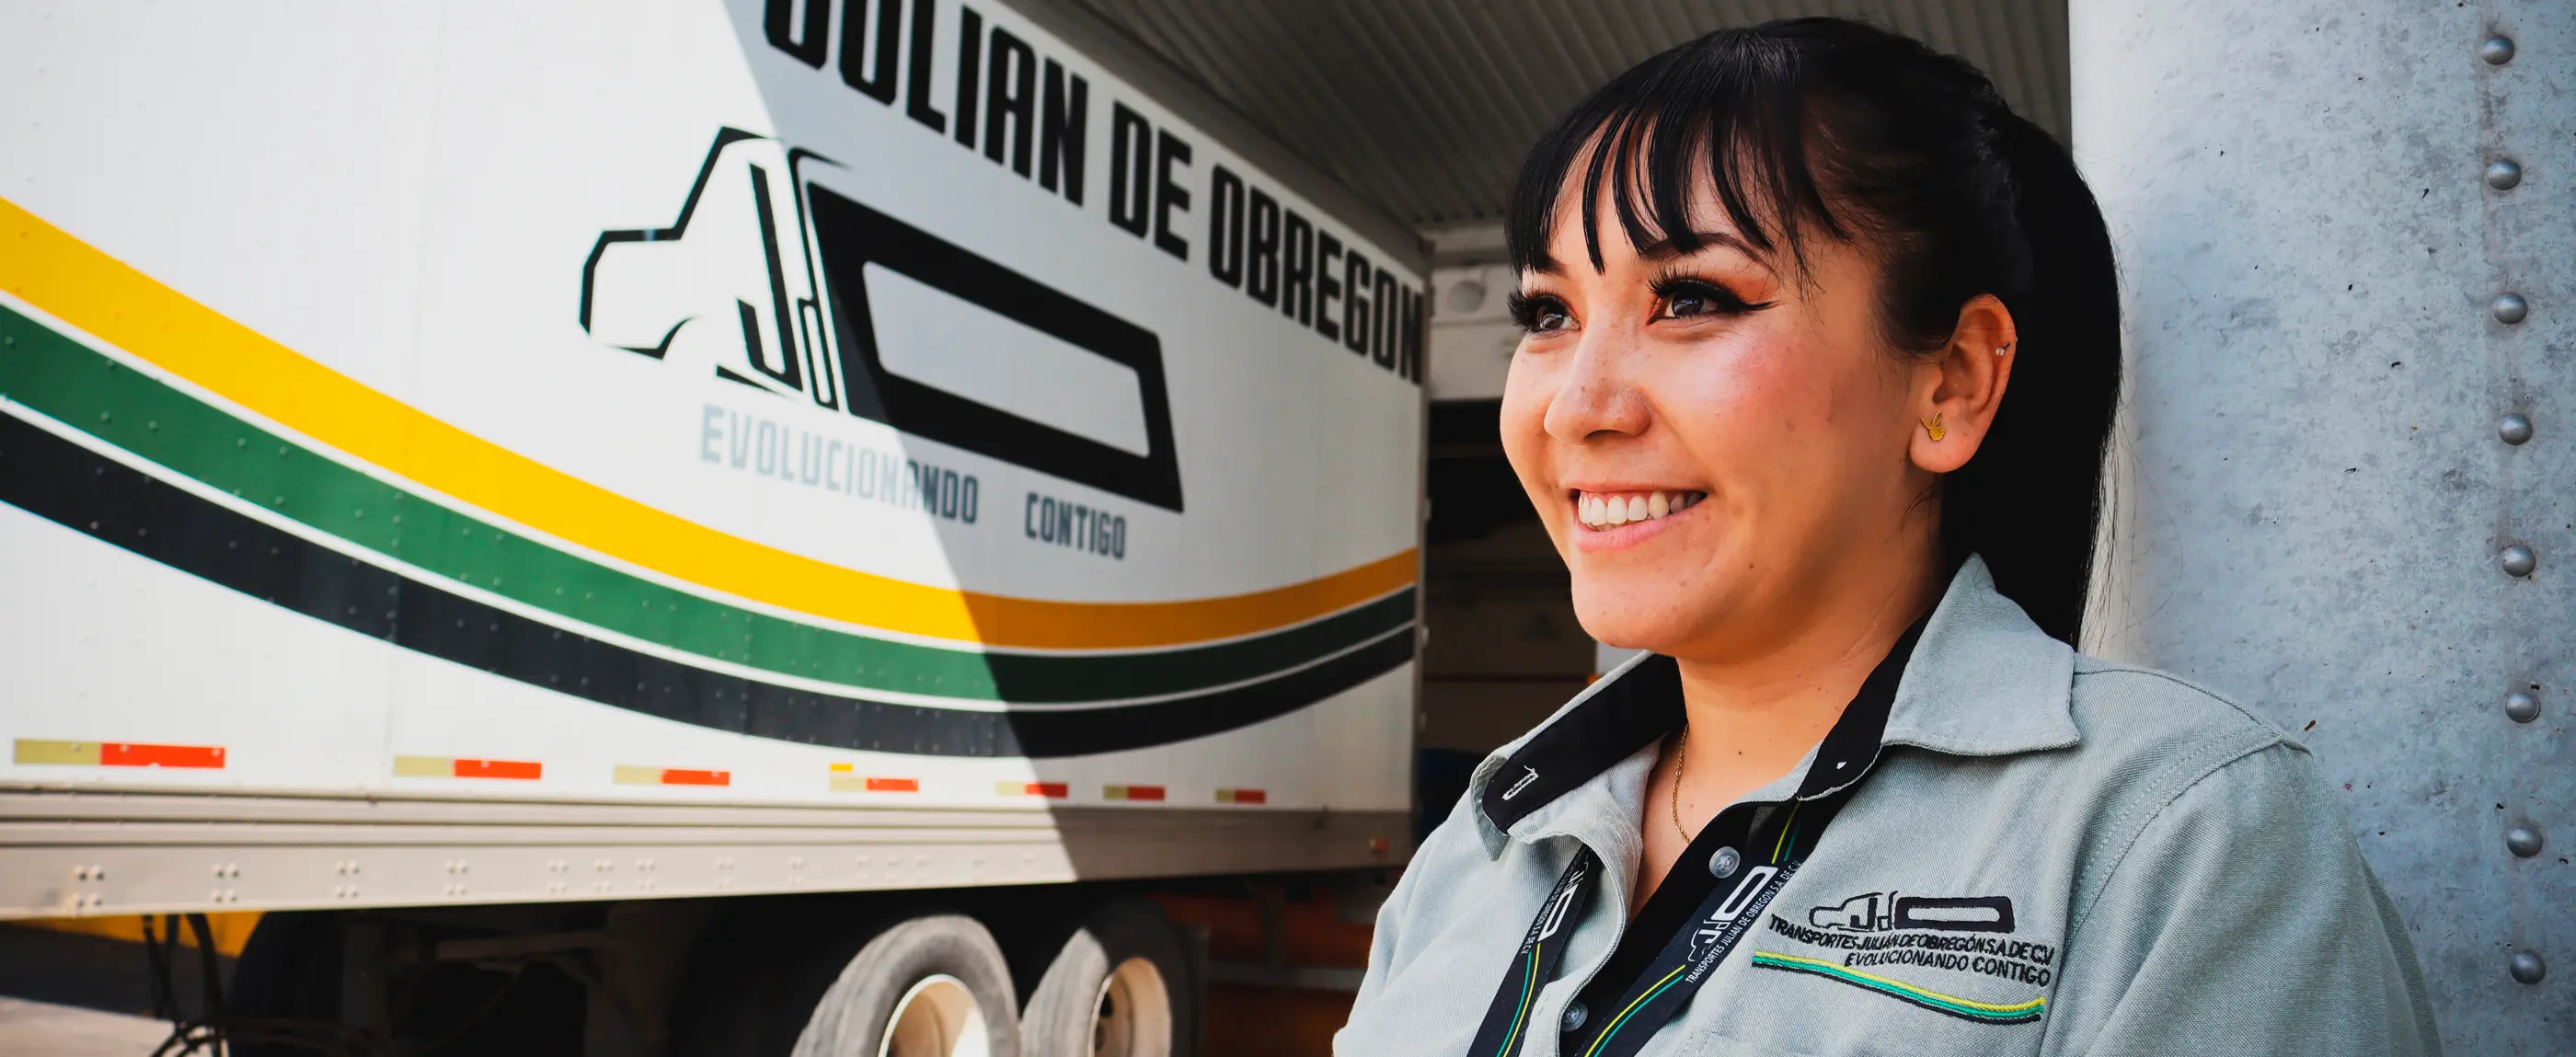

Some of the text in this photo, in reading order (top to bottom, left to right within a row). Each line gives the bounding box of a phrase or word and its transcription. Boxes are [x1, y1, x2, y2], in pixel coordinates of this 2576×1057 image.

[1109, 98, 1192, 263] DE
[1208, 162, 1424, 387] OBREGON
[699, 402, 1127, 561] EVOLUCIONANDO CONTIGO
[1685, 944, 1725, 983] TRANSPORTES
[1720, 924, 1742, 947] JULIAN
[1738, 915, 1752, 926] DE
[1746, 889, 1777, 918] OBREGON
[1779, 869, 1793, 880] DE
[1768, 913, 1859, 949] TRANSPORTES
[1844, 948, 2052, 988] EVOLUCIONANDO CONTIGO
